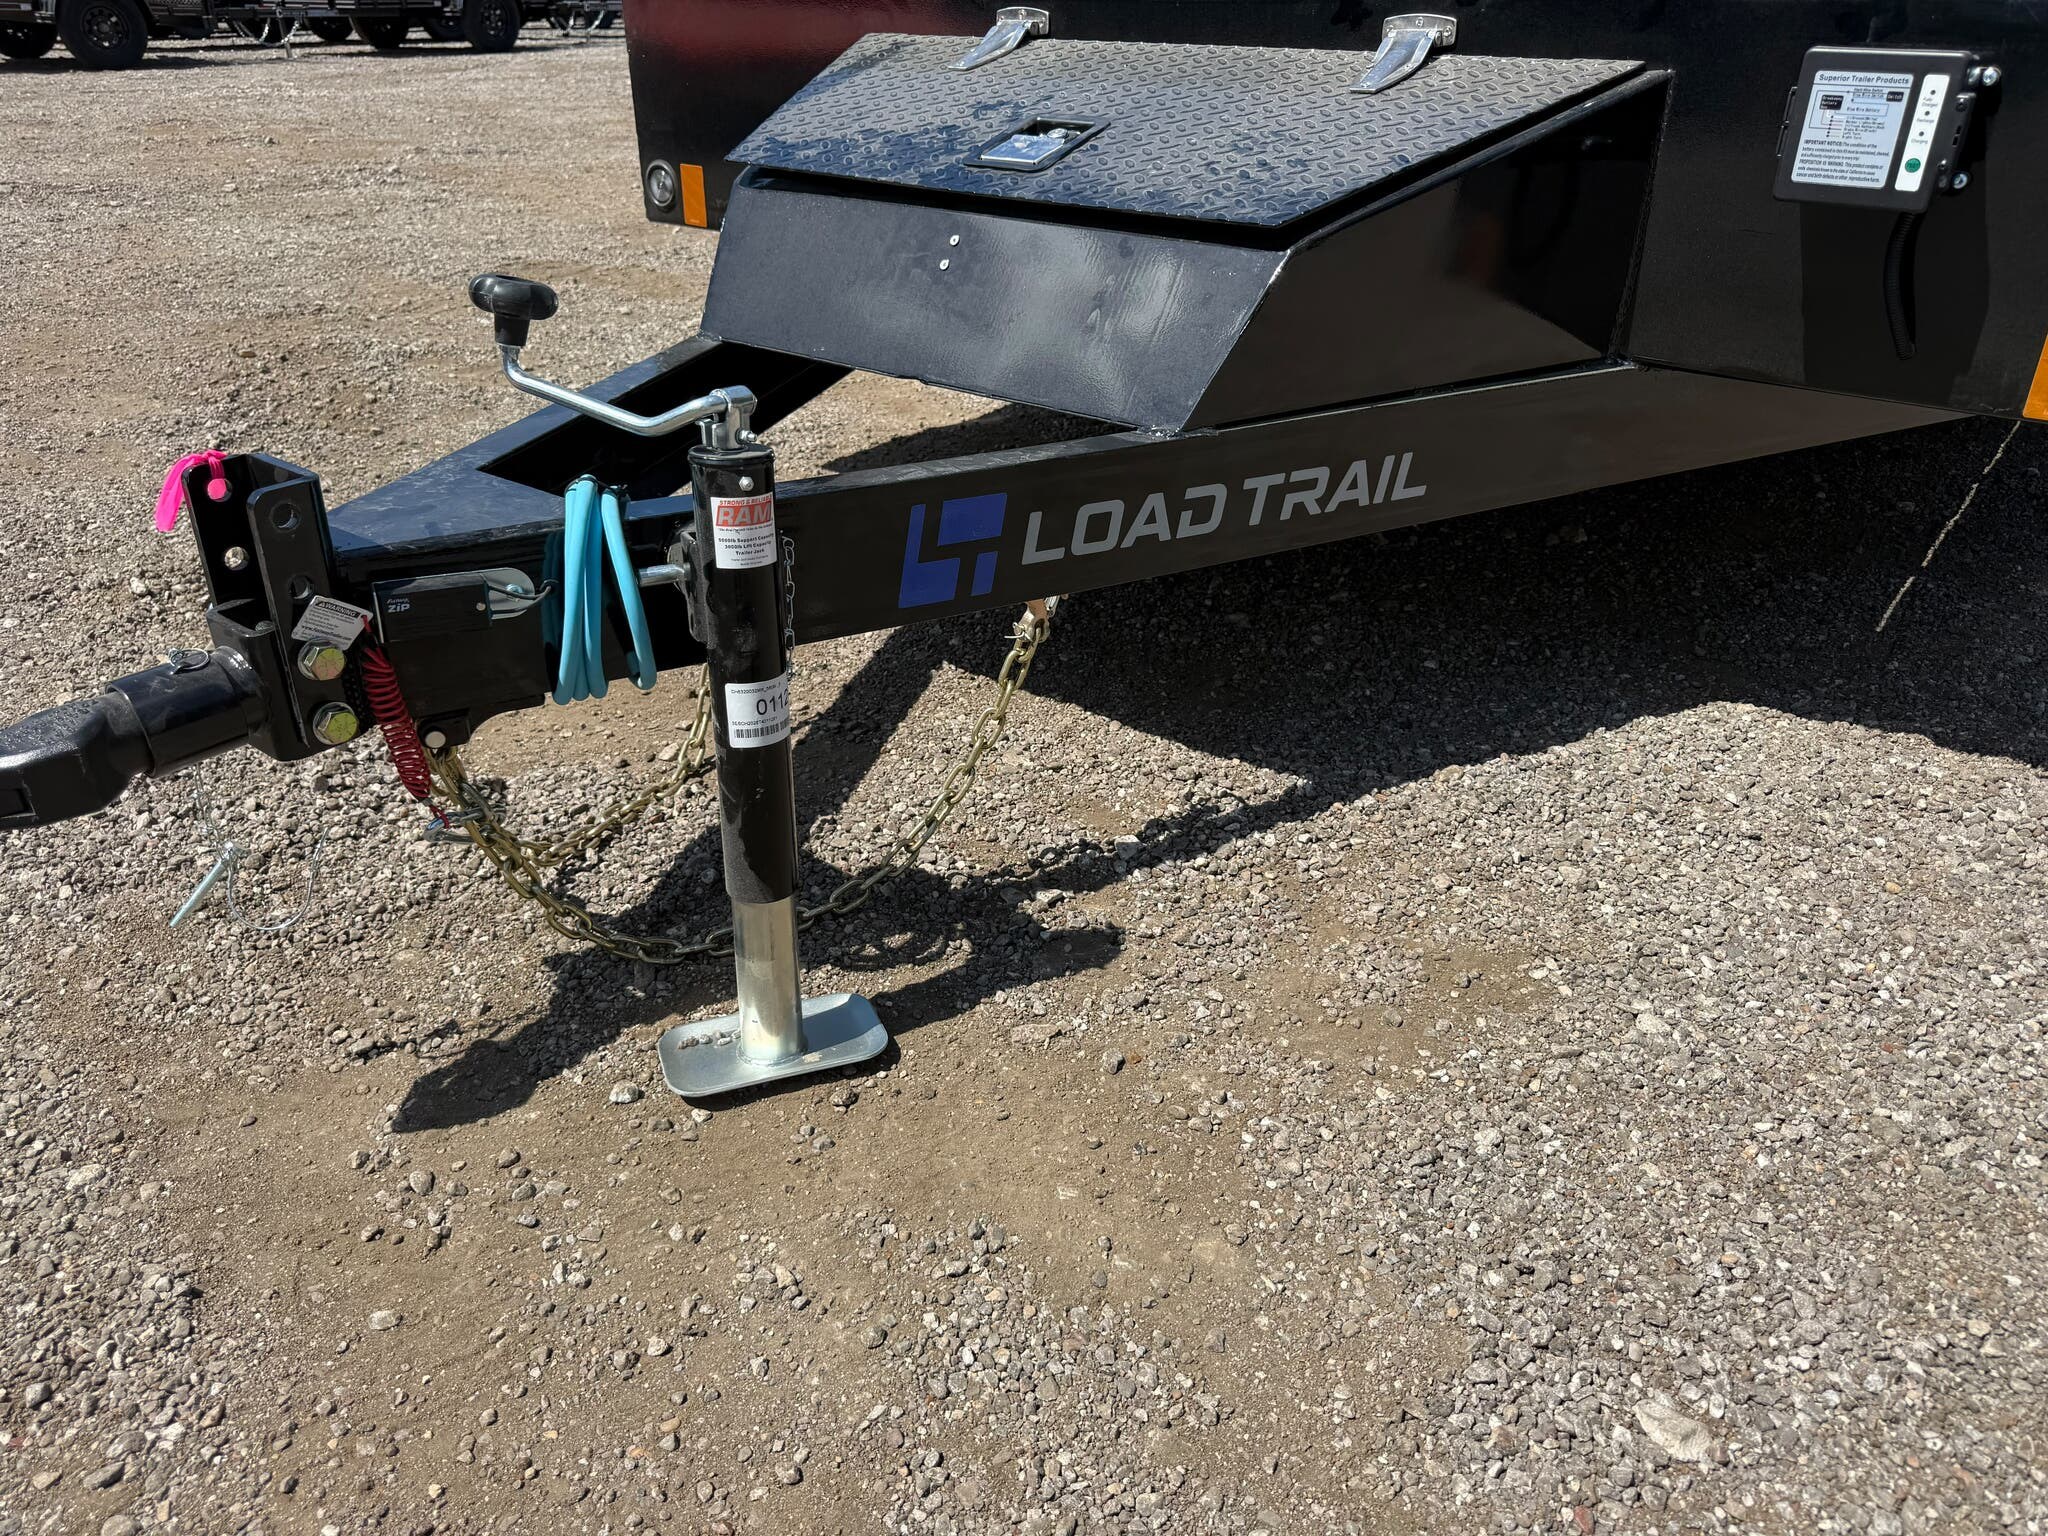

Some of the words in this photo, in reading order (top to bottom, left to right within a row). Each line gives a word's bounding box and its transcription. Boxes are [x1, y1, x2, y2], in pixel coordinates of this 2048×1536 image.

[1819, 74, 1850, 82] Superior
[1876, 76, 1909, 84] Products
[717, 501, 772, 526] RAM
[1022, 483, 1228, 566] LOAD
[1242, 451, 1428, 526] TRAIL
[325, 602, 356, 618] WARNING
